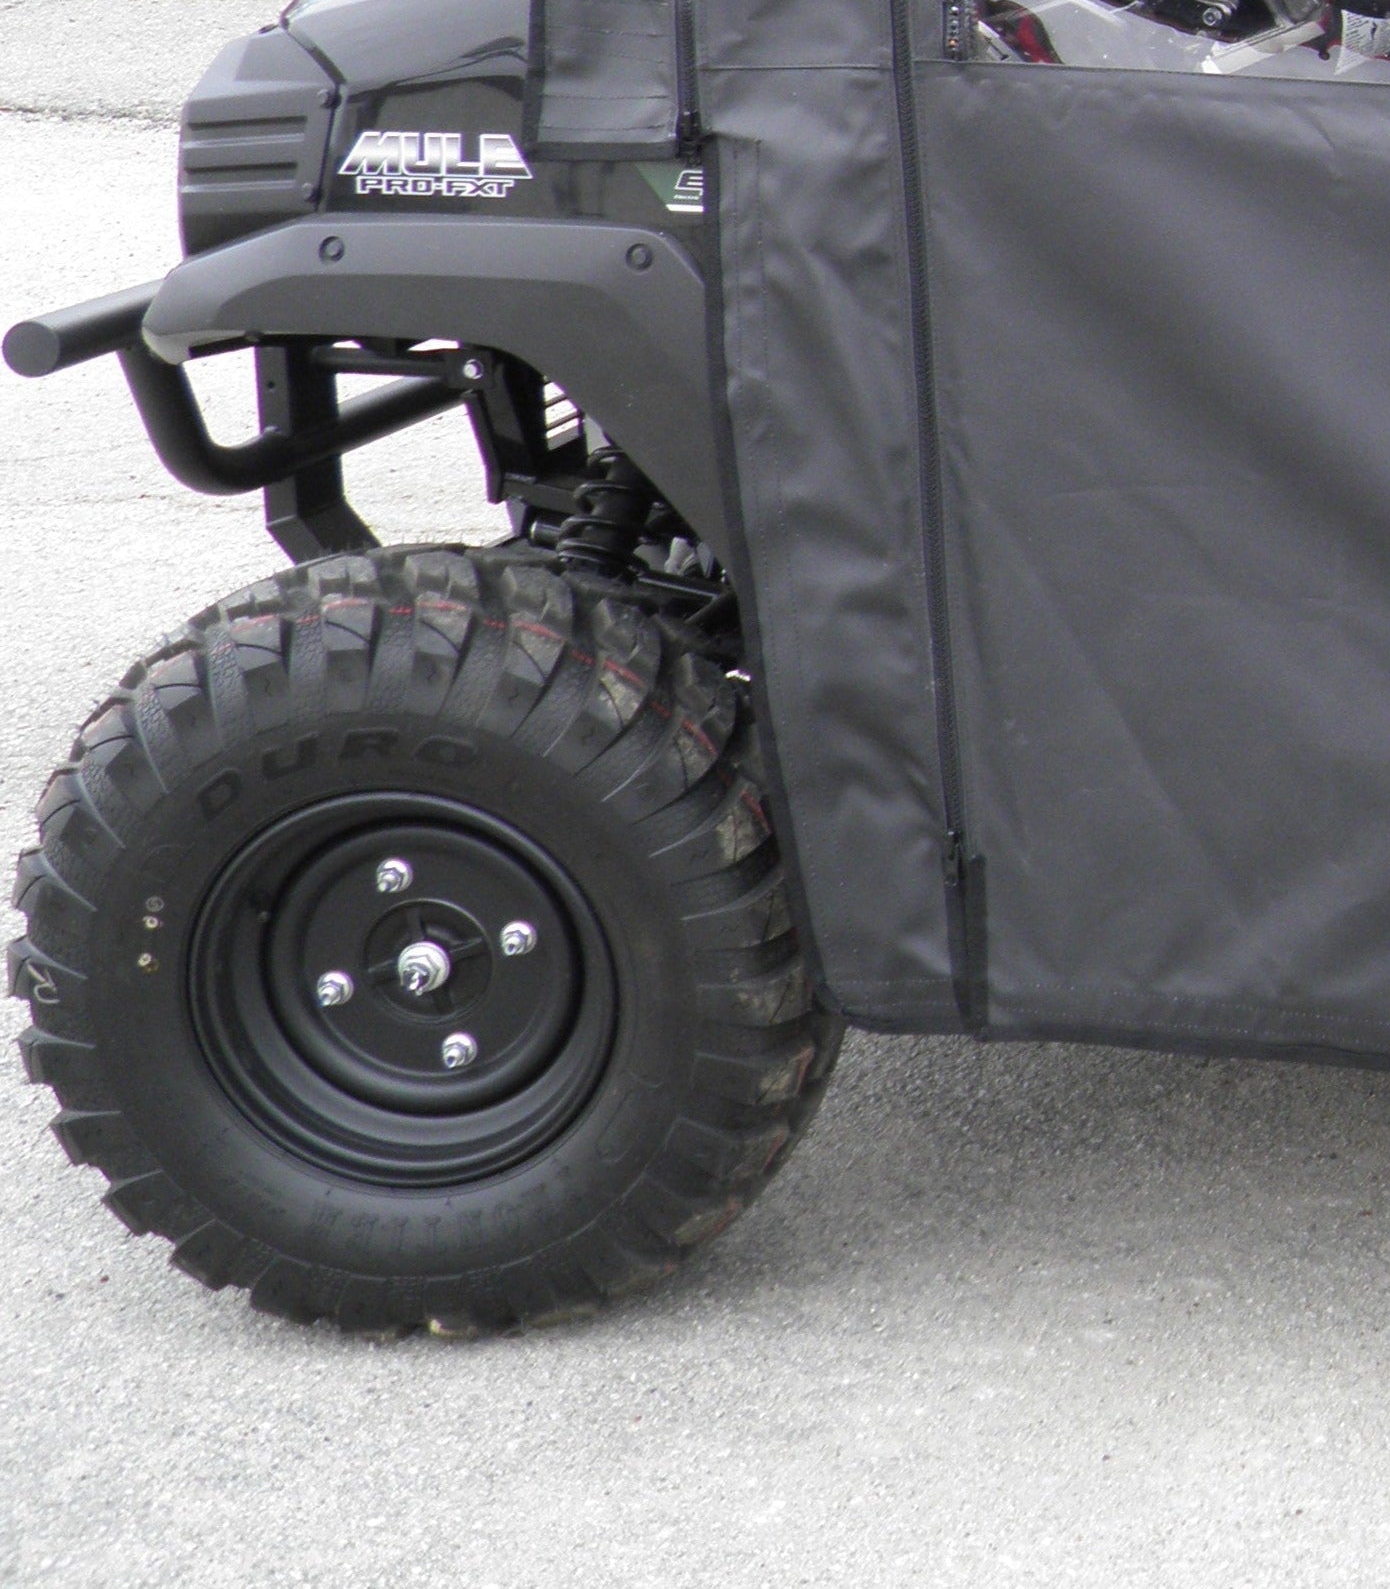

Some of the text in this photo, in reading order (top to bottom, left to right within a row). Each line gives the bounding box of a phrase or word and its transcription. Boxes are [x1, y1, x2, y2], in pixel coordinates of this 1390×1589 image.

[338, 130, 533, 179] MULE
[355, 176, 515, 198] PRO-FXT
[196, 725, 479, 817] DURO
